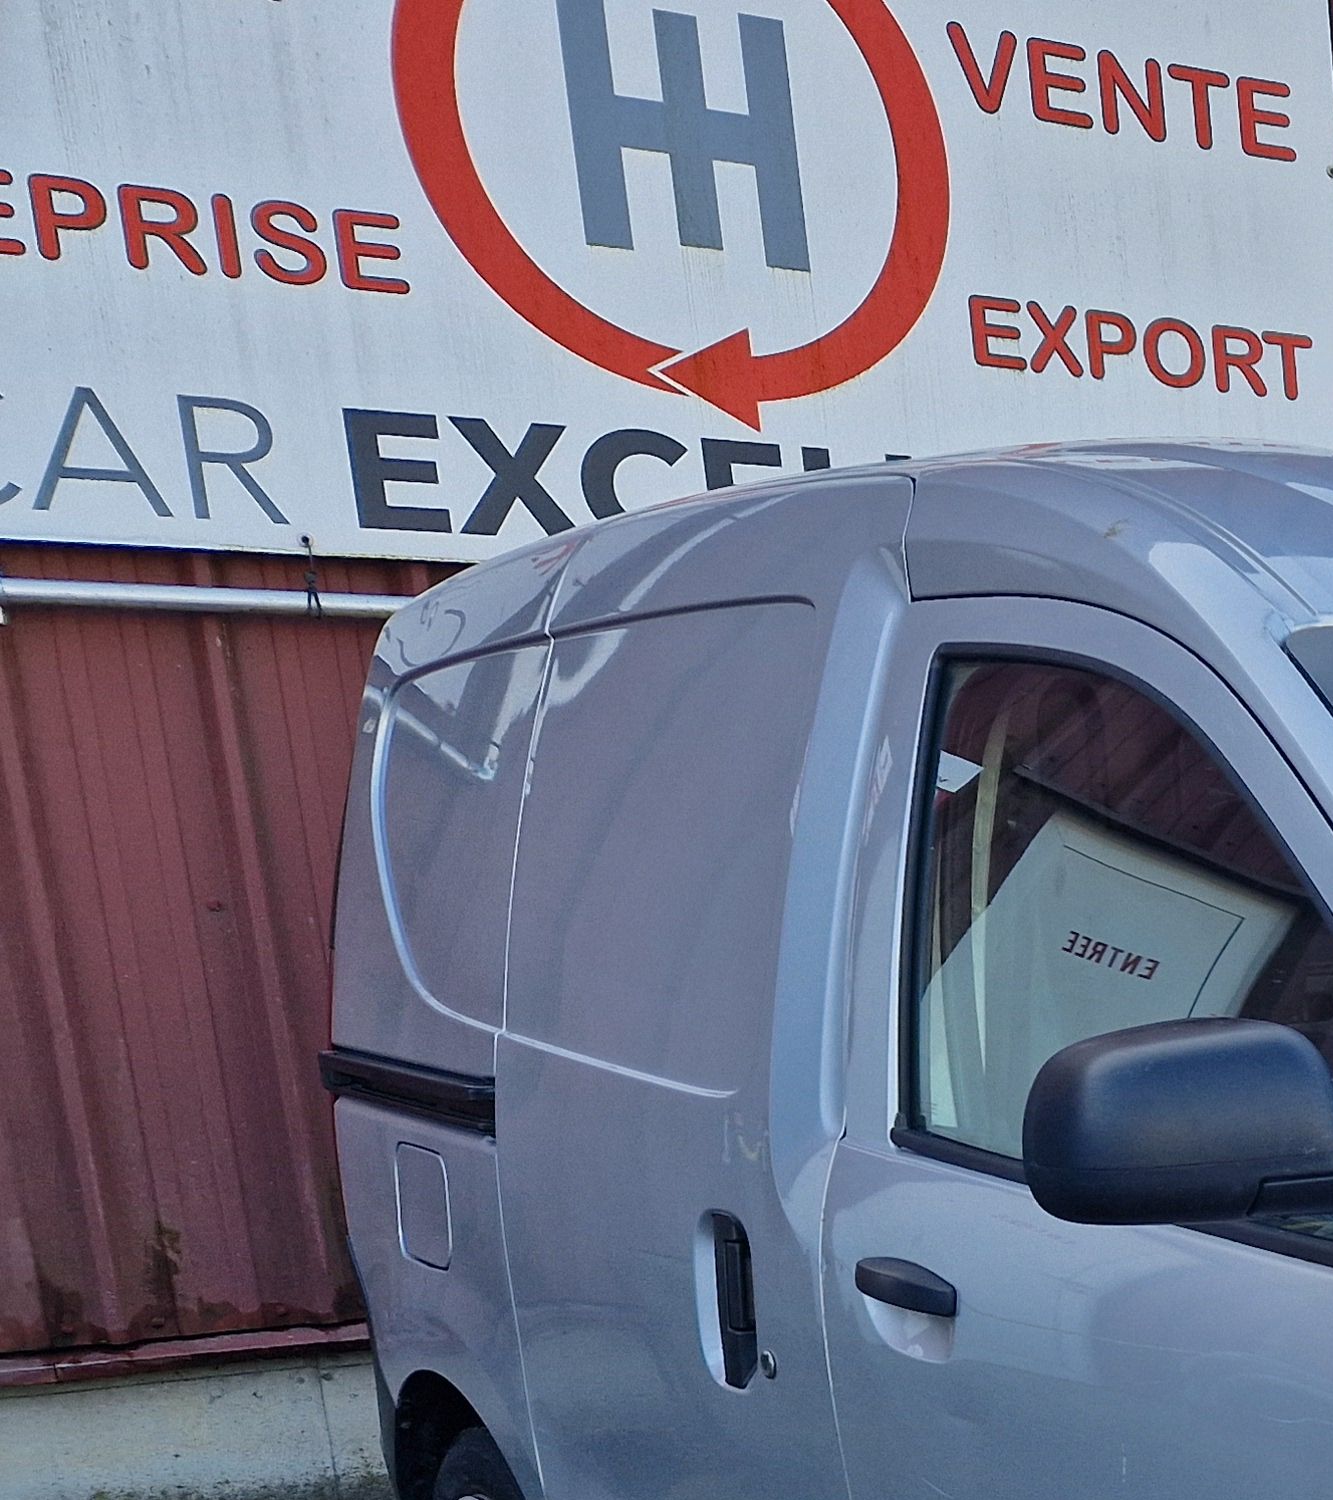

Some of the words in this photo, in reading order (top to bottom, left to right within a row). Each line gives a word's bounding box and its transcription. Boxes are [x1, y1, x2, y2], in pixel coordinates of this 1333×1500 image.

[946, 21, 1297, 162] VENTE
[968, 294, 1313, 400] EXPORT
[0, 386, 290, 525] AR
